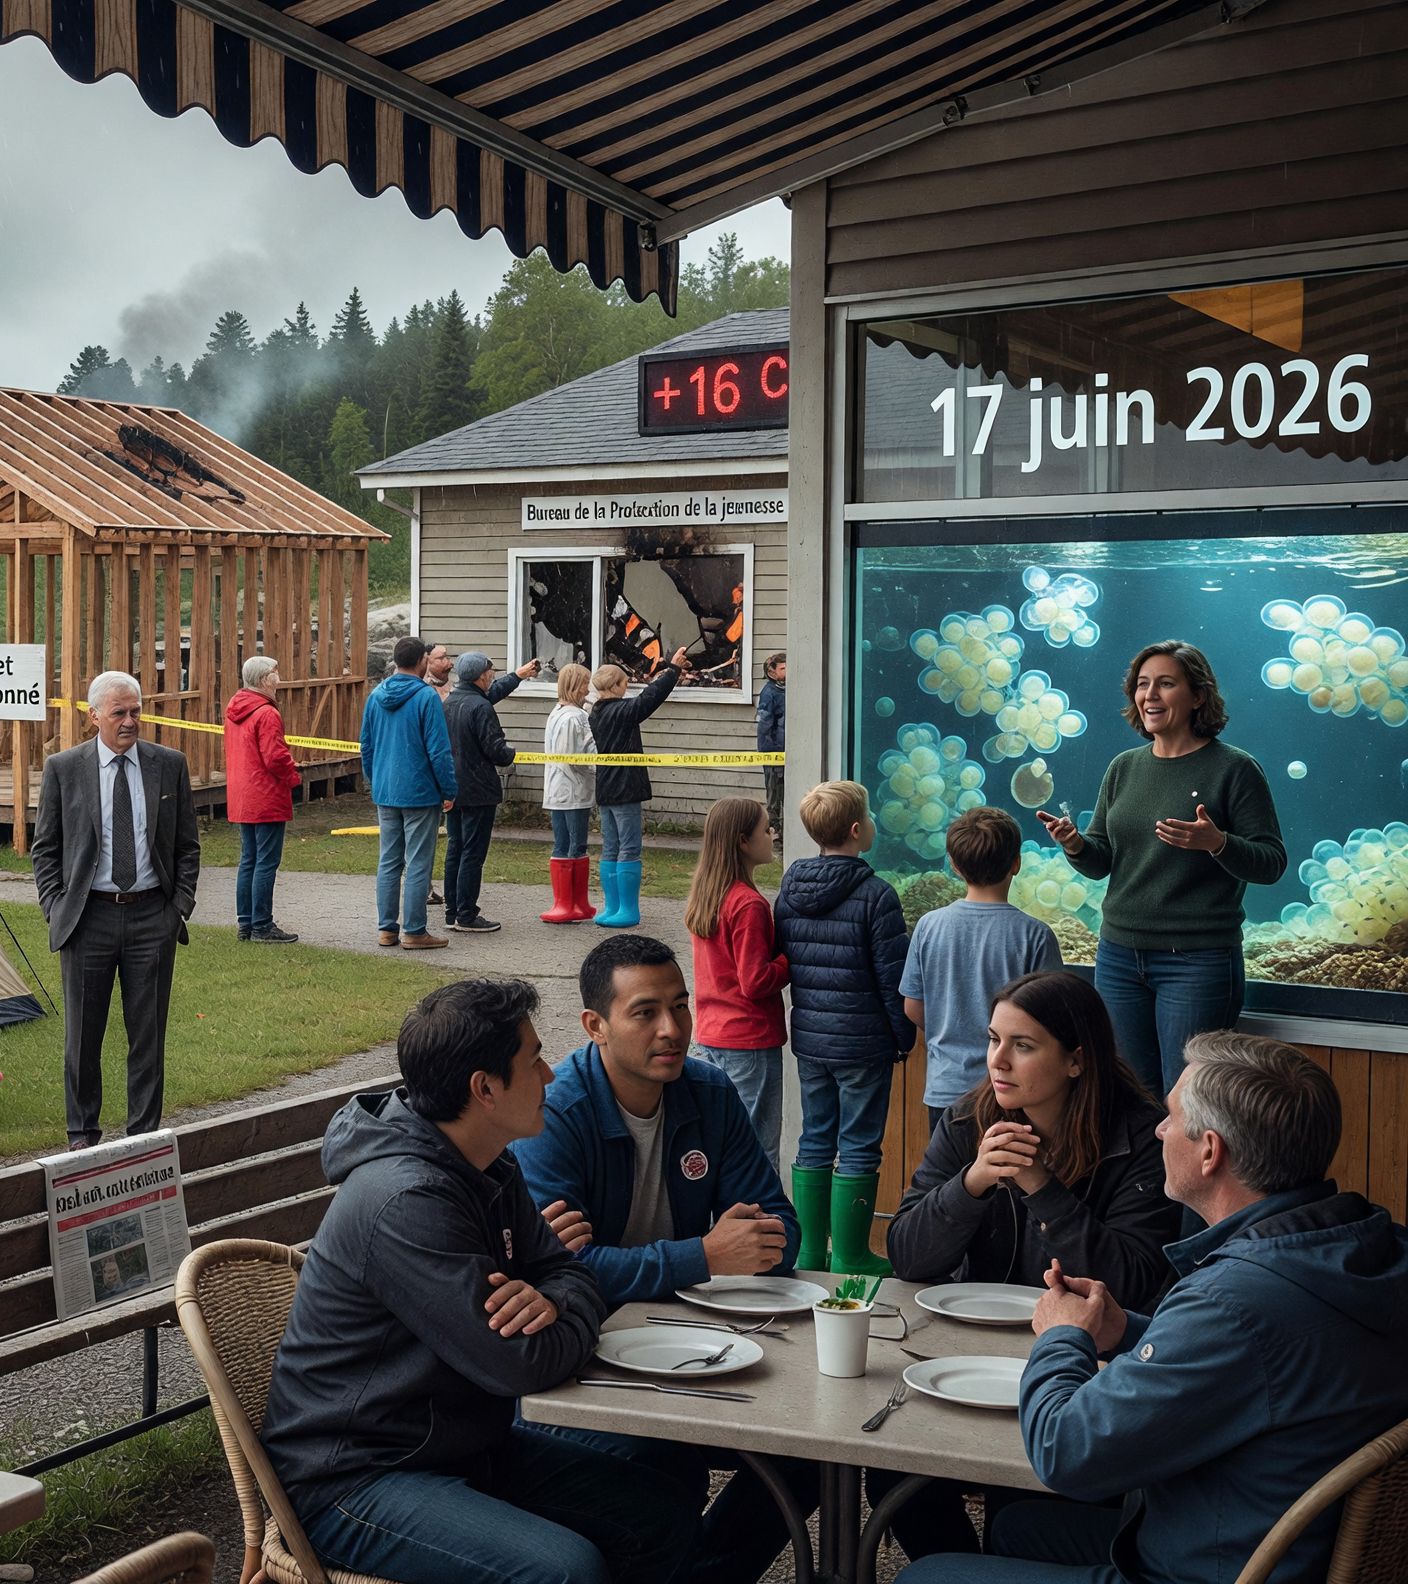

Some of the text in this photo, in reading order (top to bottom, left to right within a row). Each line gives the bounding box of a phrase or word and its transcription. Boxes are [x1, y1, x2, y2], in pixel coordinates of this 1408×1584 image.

[652, 355, 788, 415] +16 C
[929, 353, 1372, 474] 17 juin 2026
[527, 504, 570, 521] Bureau
[574, 502, 590, 520] de
[594, 501, 606, 520] la
[684, 497, 701, 516] de
[705, 497, 717, 516] la
